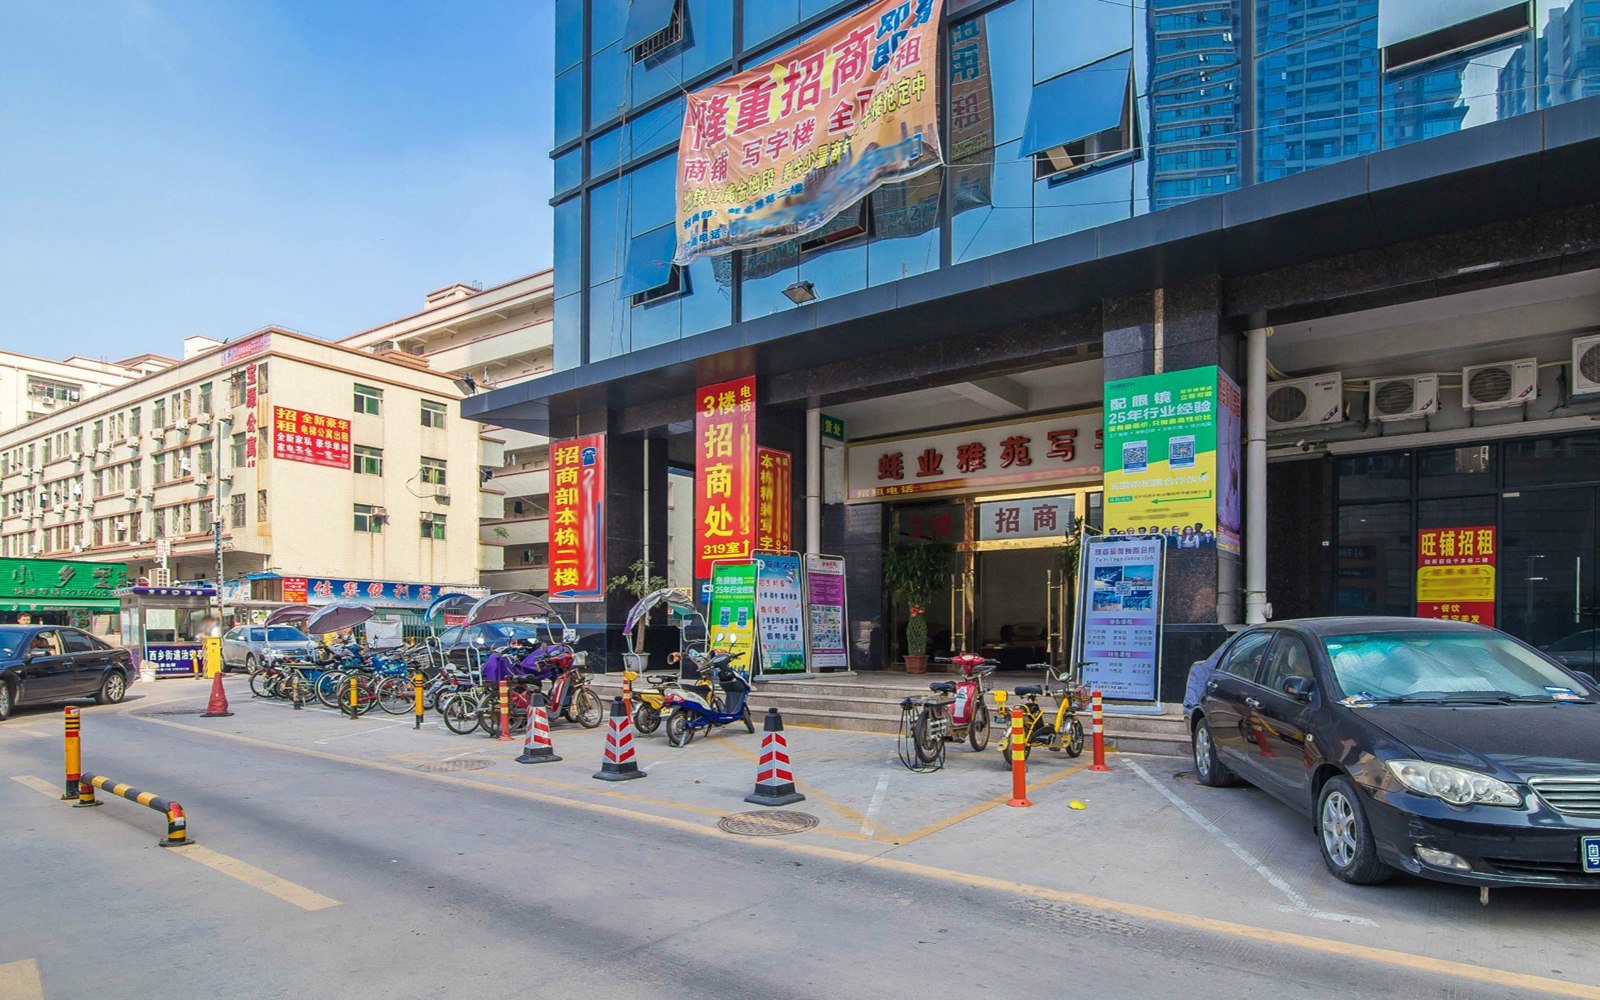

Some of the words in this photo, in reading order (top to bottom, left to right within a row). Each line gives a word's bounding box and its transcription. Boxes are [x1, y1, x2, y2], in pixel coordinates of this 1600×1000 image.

[691, 23, 876, 151] 隆重招商
[683, 149, 729, 185] 商铺
[740, 116, 816, 168] 写字楼
[682, 168, 775, 212] 地铁口黄金地段
[301, 413, 349, 431] 全新豪华
[1109, 400, 1211, 424] 25年行业经验
[301, 424, 349, 442] 电梯公寓出租
[704, 422, 733, 538] 招商处
[554, 446, 579, 587] 招商部本栋二楼
[995, 503, 1059, 533] 招商
[703, 541, 741, 554] 319室
[1421, 529, 1493, 557] 旺铺招租
[1441, 604, 1460, 613] 餐饮
